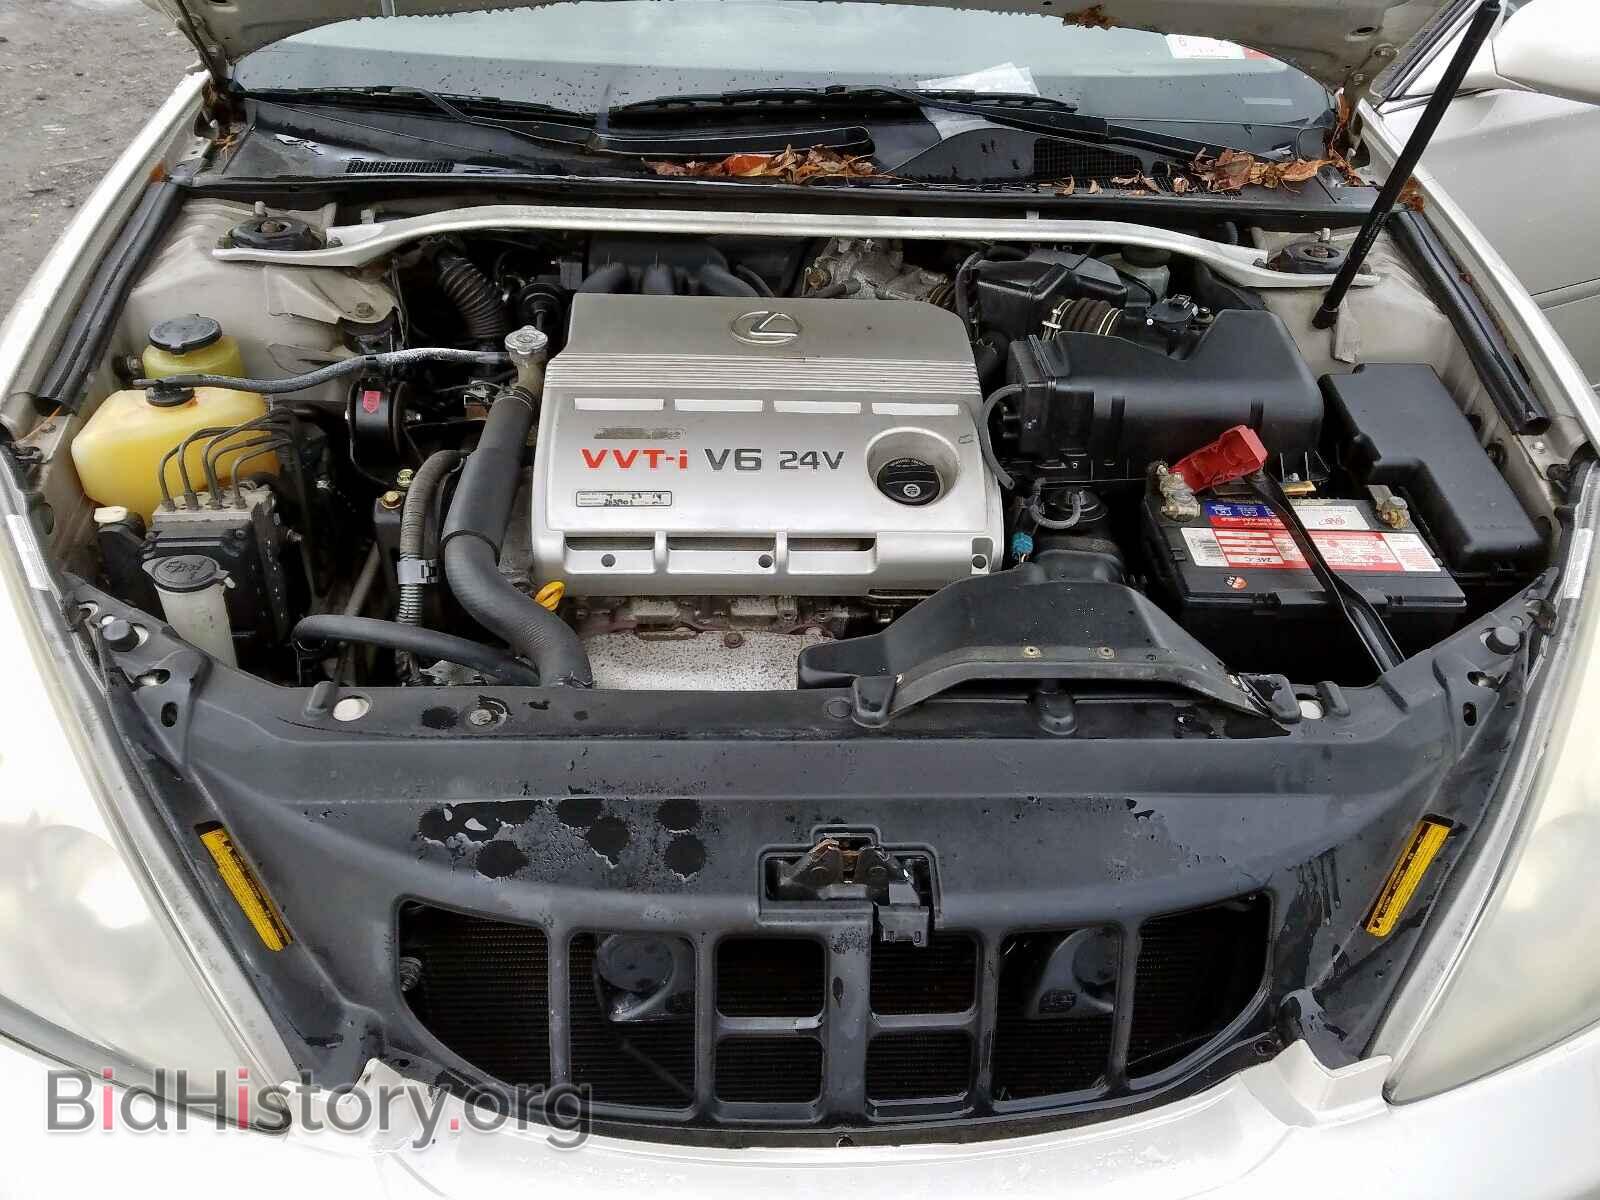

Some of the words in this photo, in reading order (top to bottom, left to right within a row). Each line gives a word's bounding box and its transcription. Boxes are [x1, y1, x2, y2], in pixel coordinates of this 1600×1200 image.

[581, 448, 688, 469] VVT-i
[704, 448, 762, 471] V6
[779, 450, 845, 470] 24V
